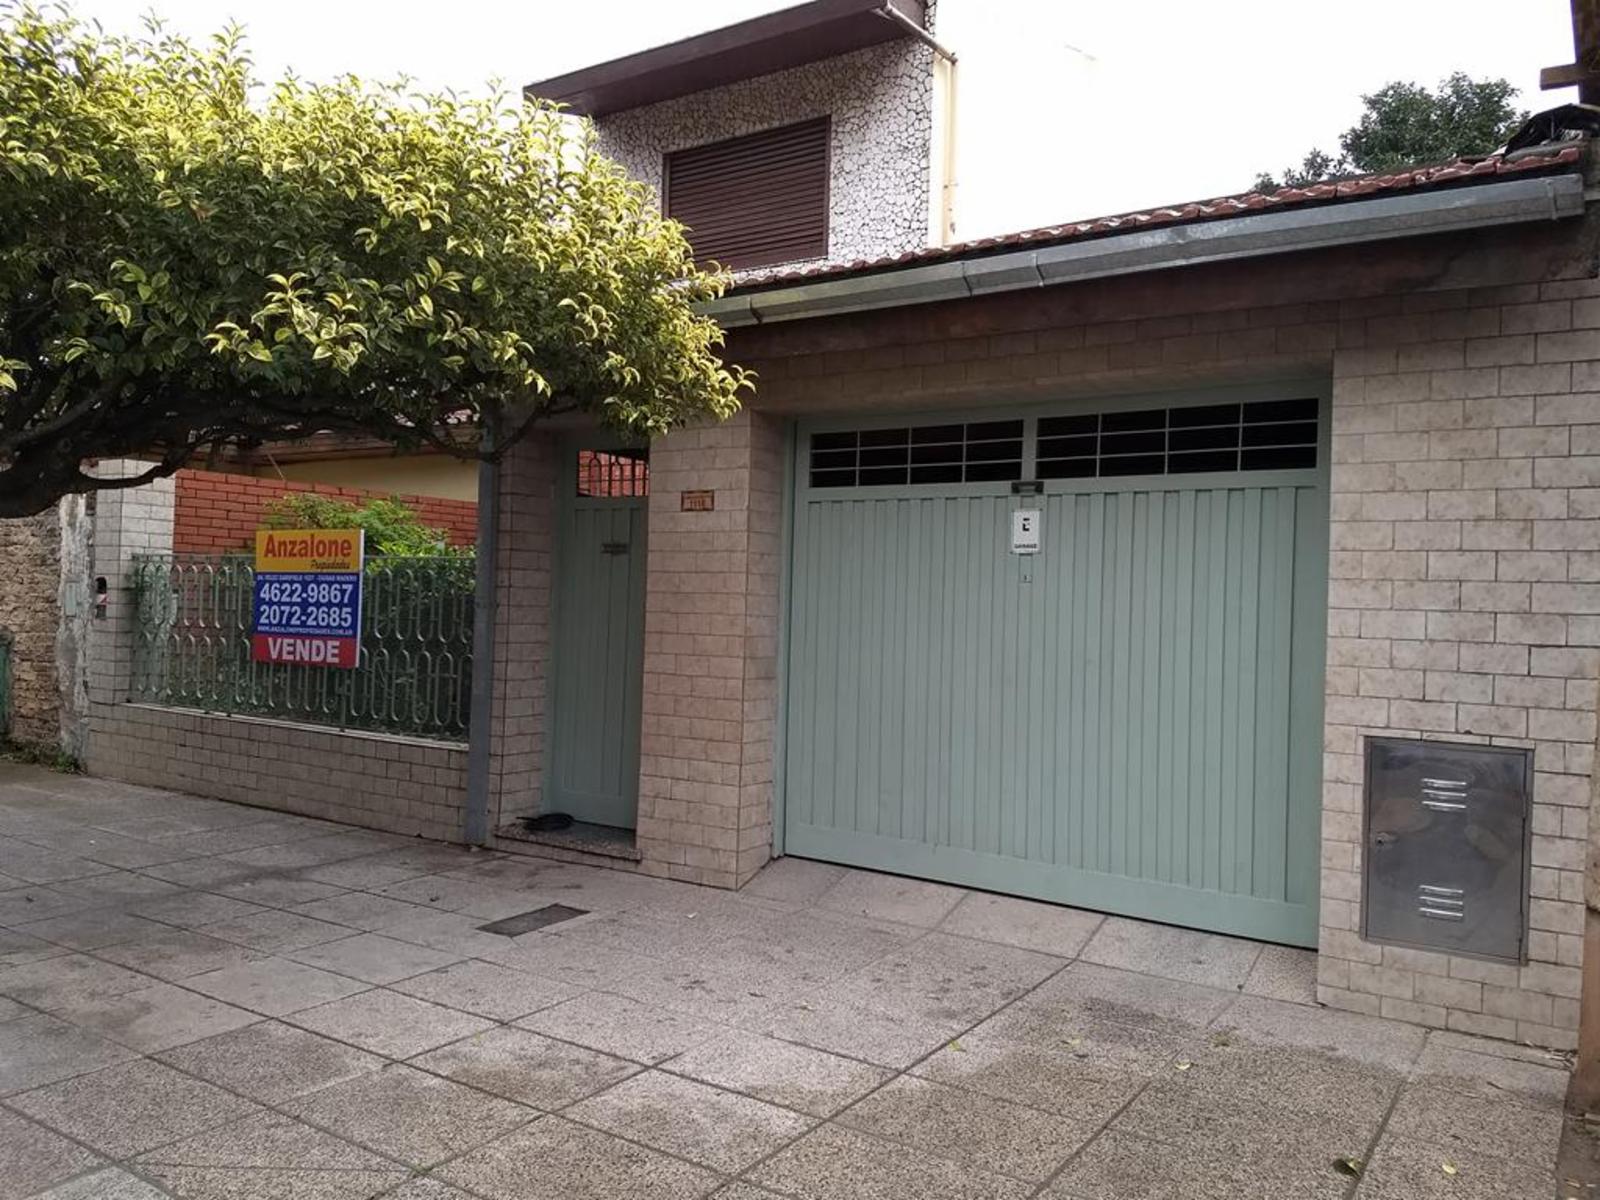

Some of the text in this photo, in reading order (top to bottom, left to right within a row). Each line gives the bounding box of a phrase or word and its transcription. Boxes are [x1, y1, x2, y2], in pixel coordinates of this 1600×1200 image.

[263, 534, 352, 558] Anzalone
[260, 583, 353, 603] 4622-9867
[259, 605, 352, 627] 2072-2685
[268, 637, 341, 663] VENDE
